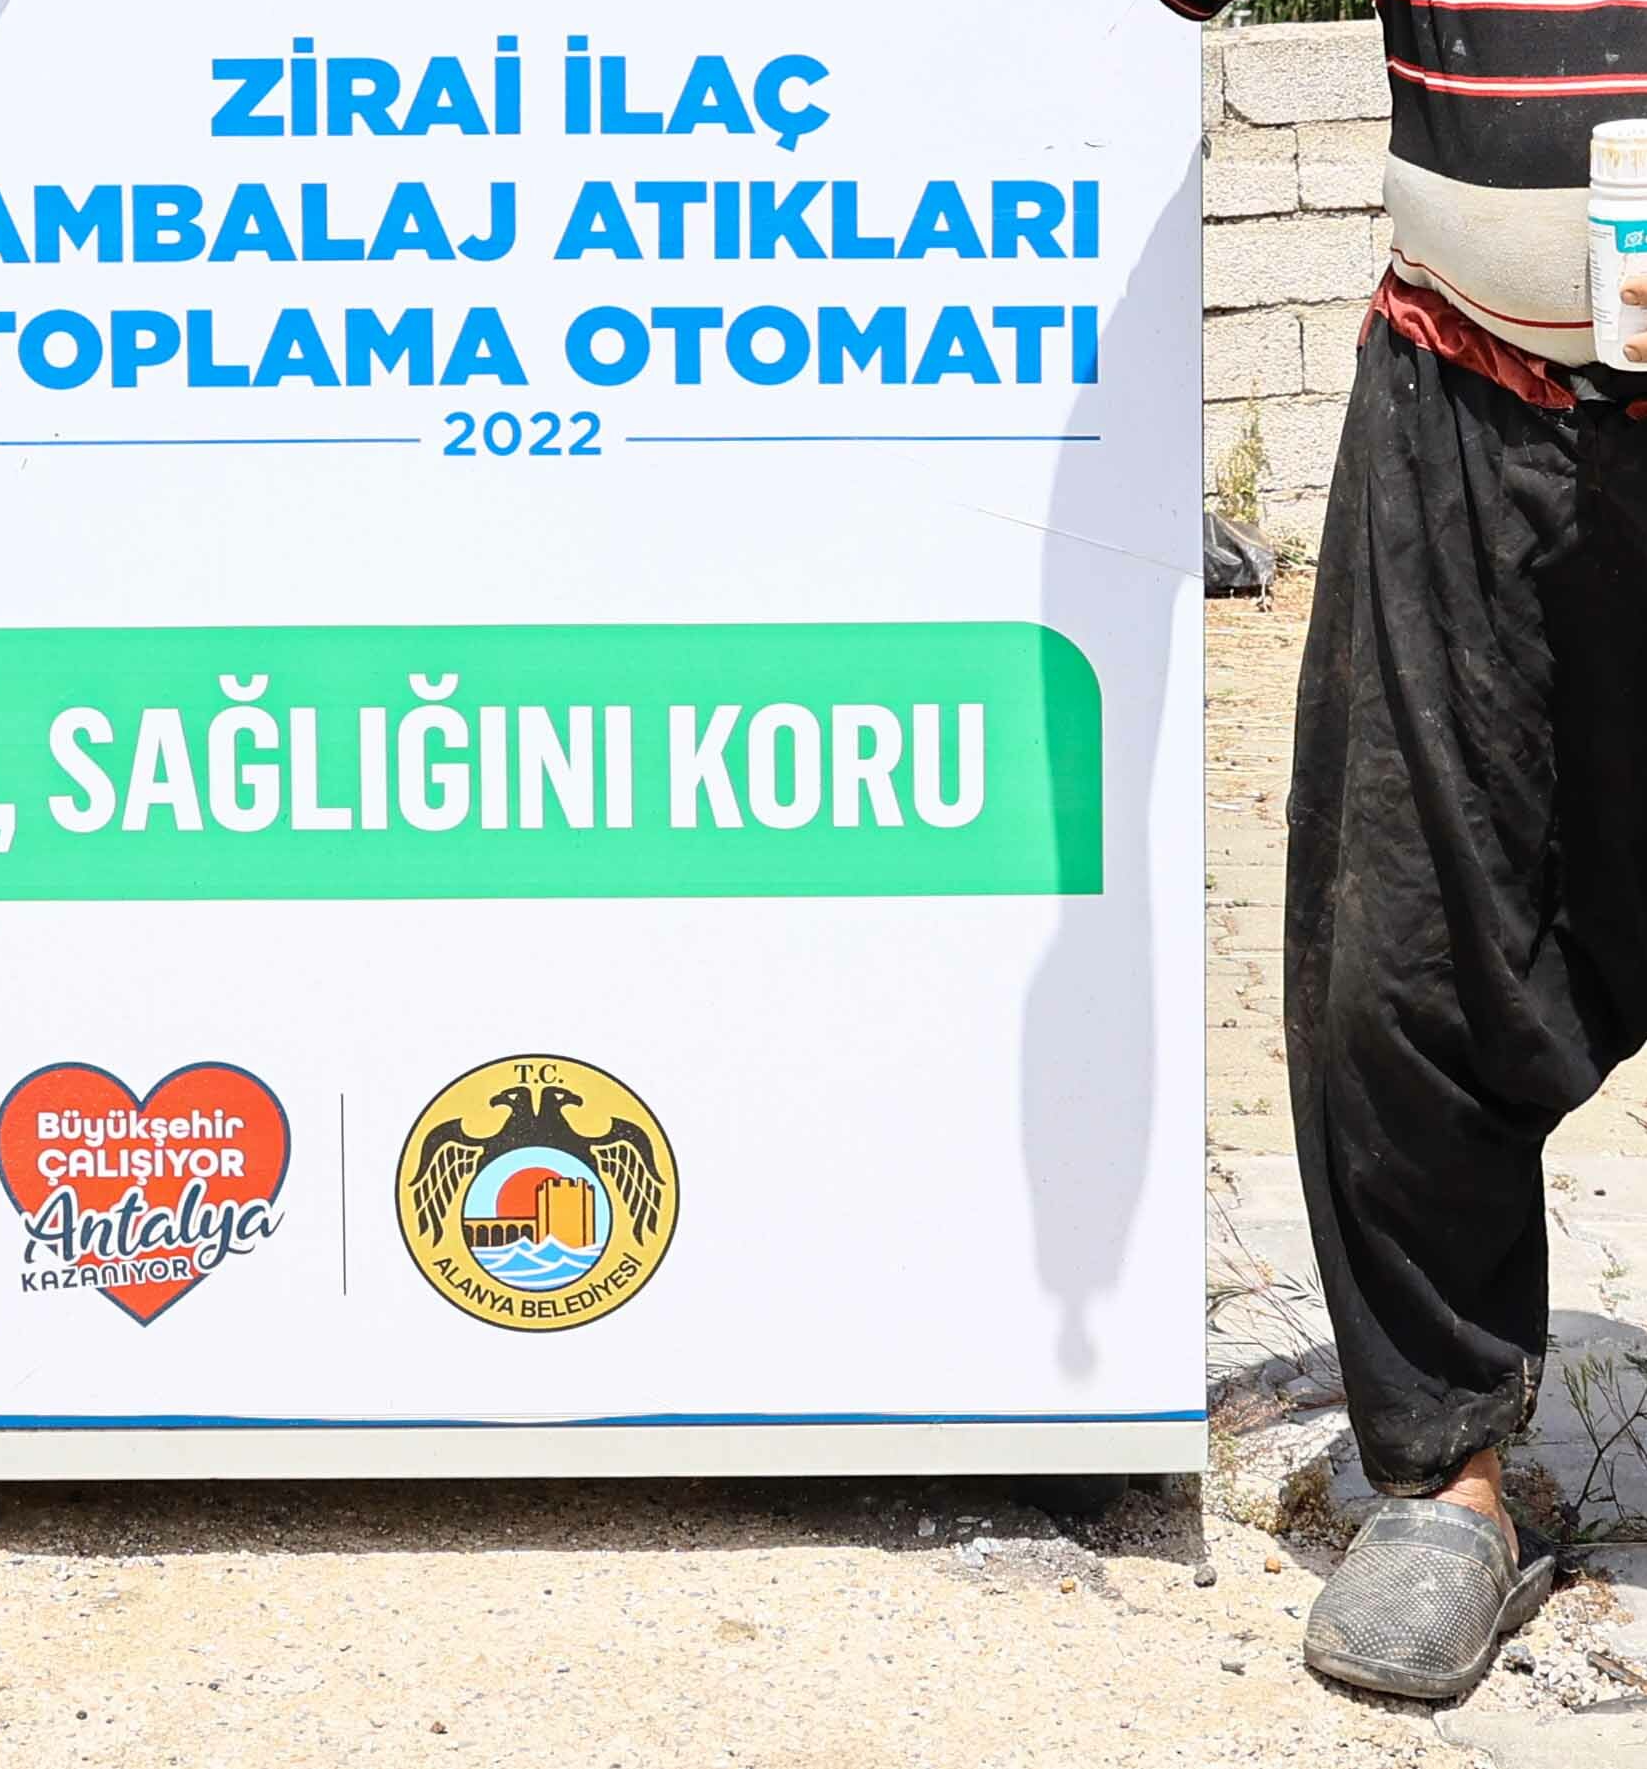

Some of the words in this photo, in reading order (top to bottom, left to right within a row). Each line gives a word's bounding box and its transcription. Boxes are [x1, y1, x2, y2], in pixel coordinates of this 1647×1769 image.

[211, 35, 521, 137] ZİRAİ
[565, 35, 830, 152] İLAÇ
[554, 180, 1099, 260] ATIKLARI
[565, 305, 1099, 387] OTOMATI
[443, 411, 602, 456] 2022
[48, 674, 632, 833] SAĞLIĞINI
[669, 703, 985, 829] KORU
[514, 1064, 564, 1084] T.C.
[37, 1109, 244, 1147] Büyükşehir
[23, 1183, 285, 1270] Antalya
[21, 1258, 190, 1292] KAZANIYOR
[433, 1257, 514, 1316] ALANYA
[521, 1252, 643, 1318] BELEDİYESİ
